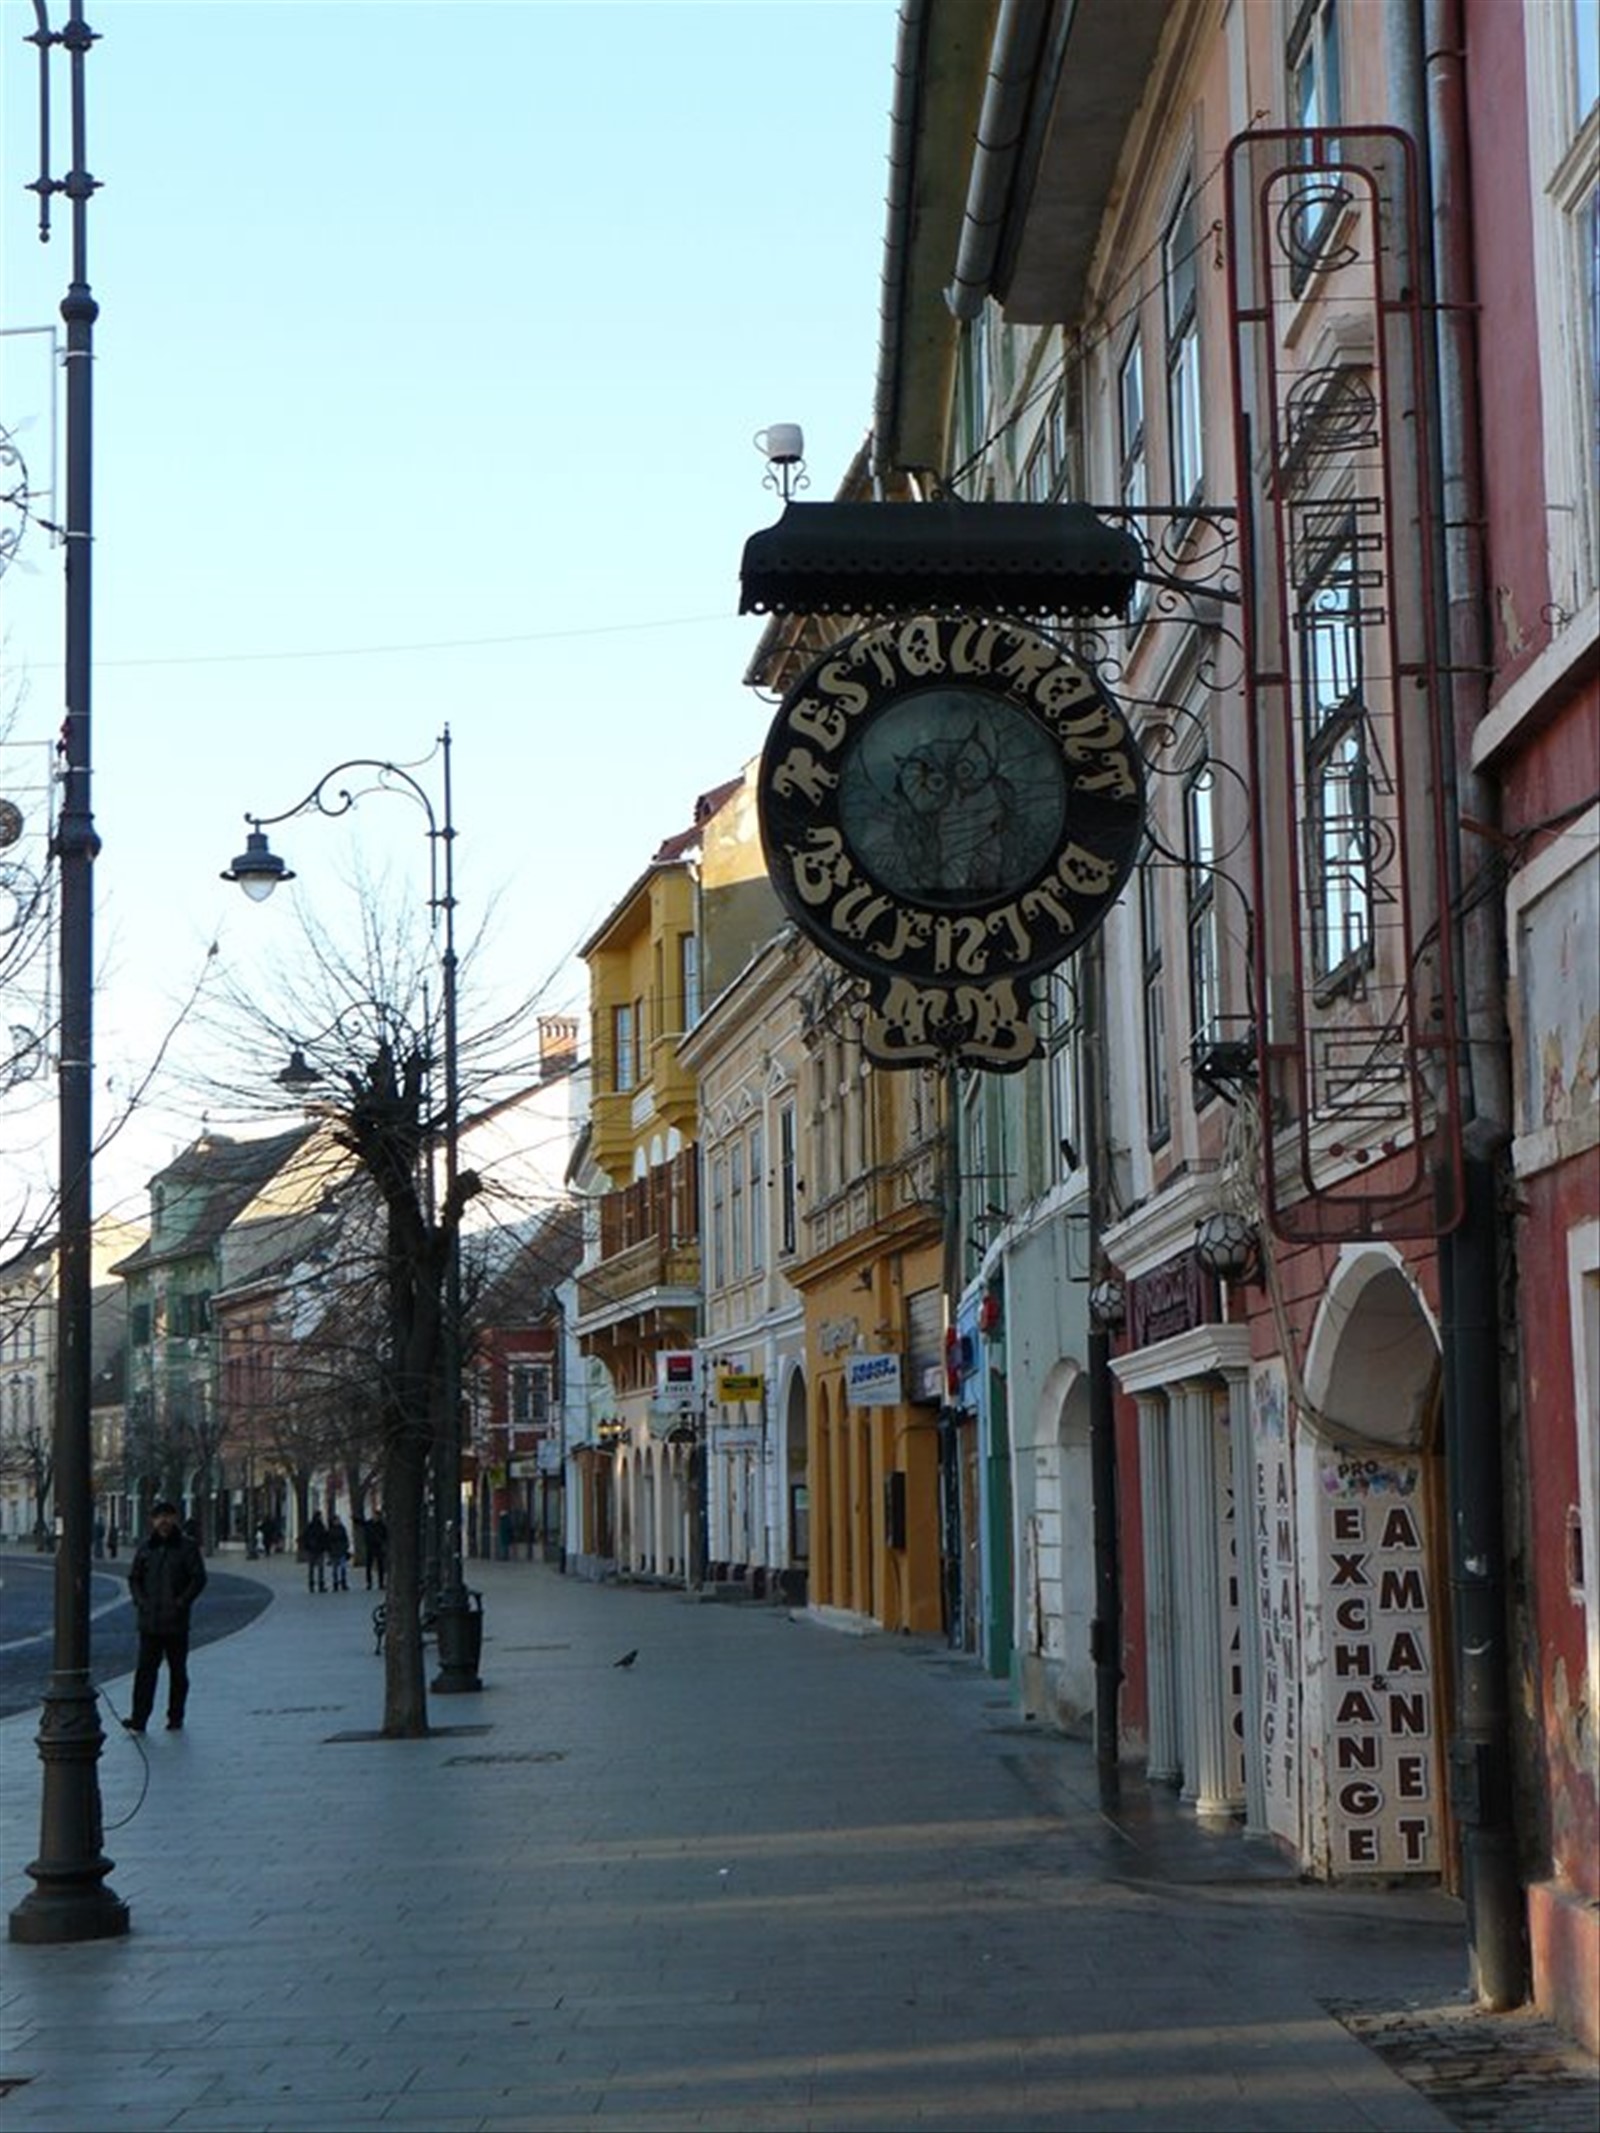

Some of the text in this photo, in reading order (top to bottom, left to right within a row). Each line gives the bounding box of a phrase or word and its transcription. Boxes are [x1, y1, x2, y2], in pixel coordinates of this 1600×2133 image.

[1331, 1507, 1382, 1862] EXCHANGE
[1371, 1673, 1389, 1692] &
[1380, 1507, 1426, 1861] AMANET
